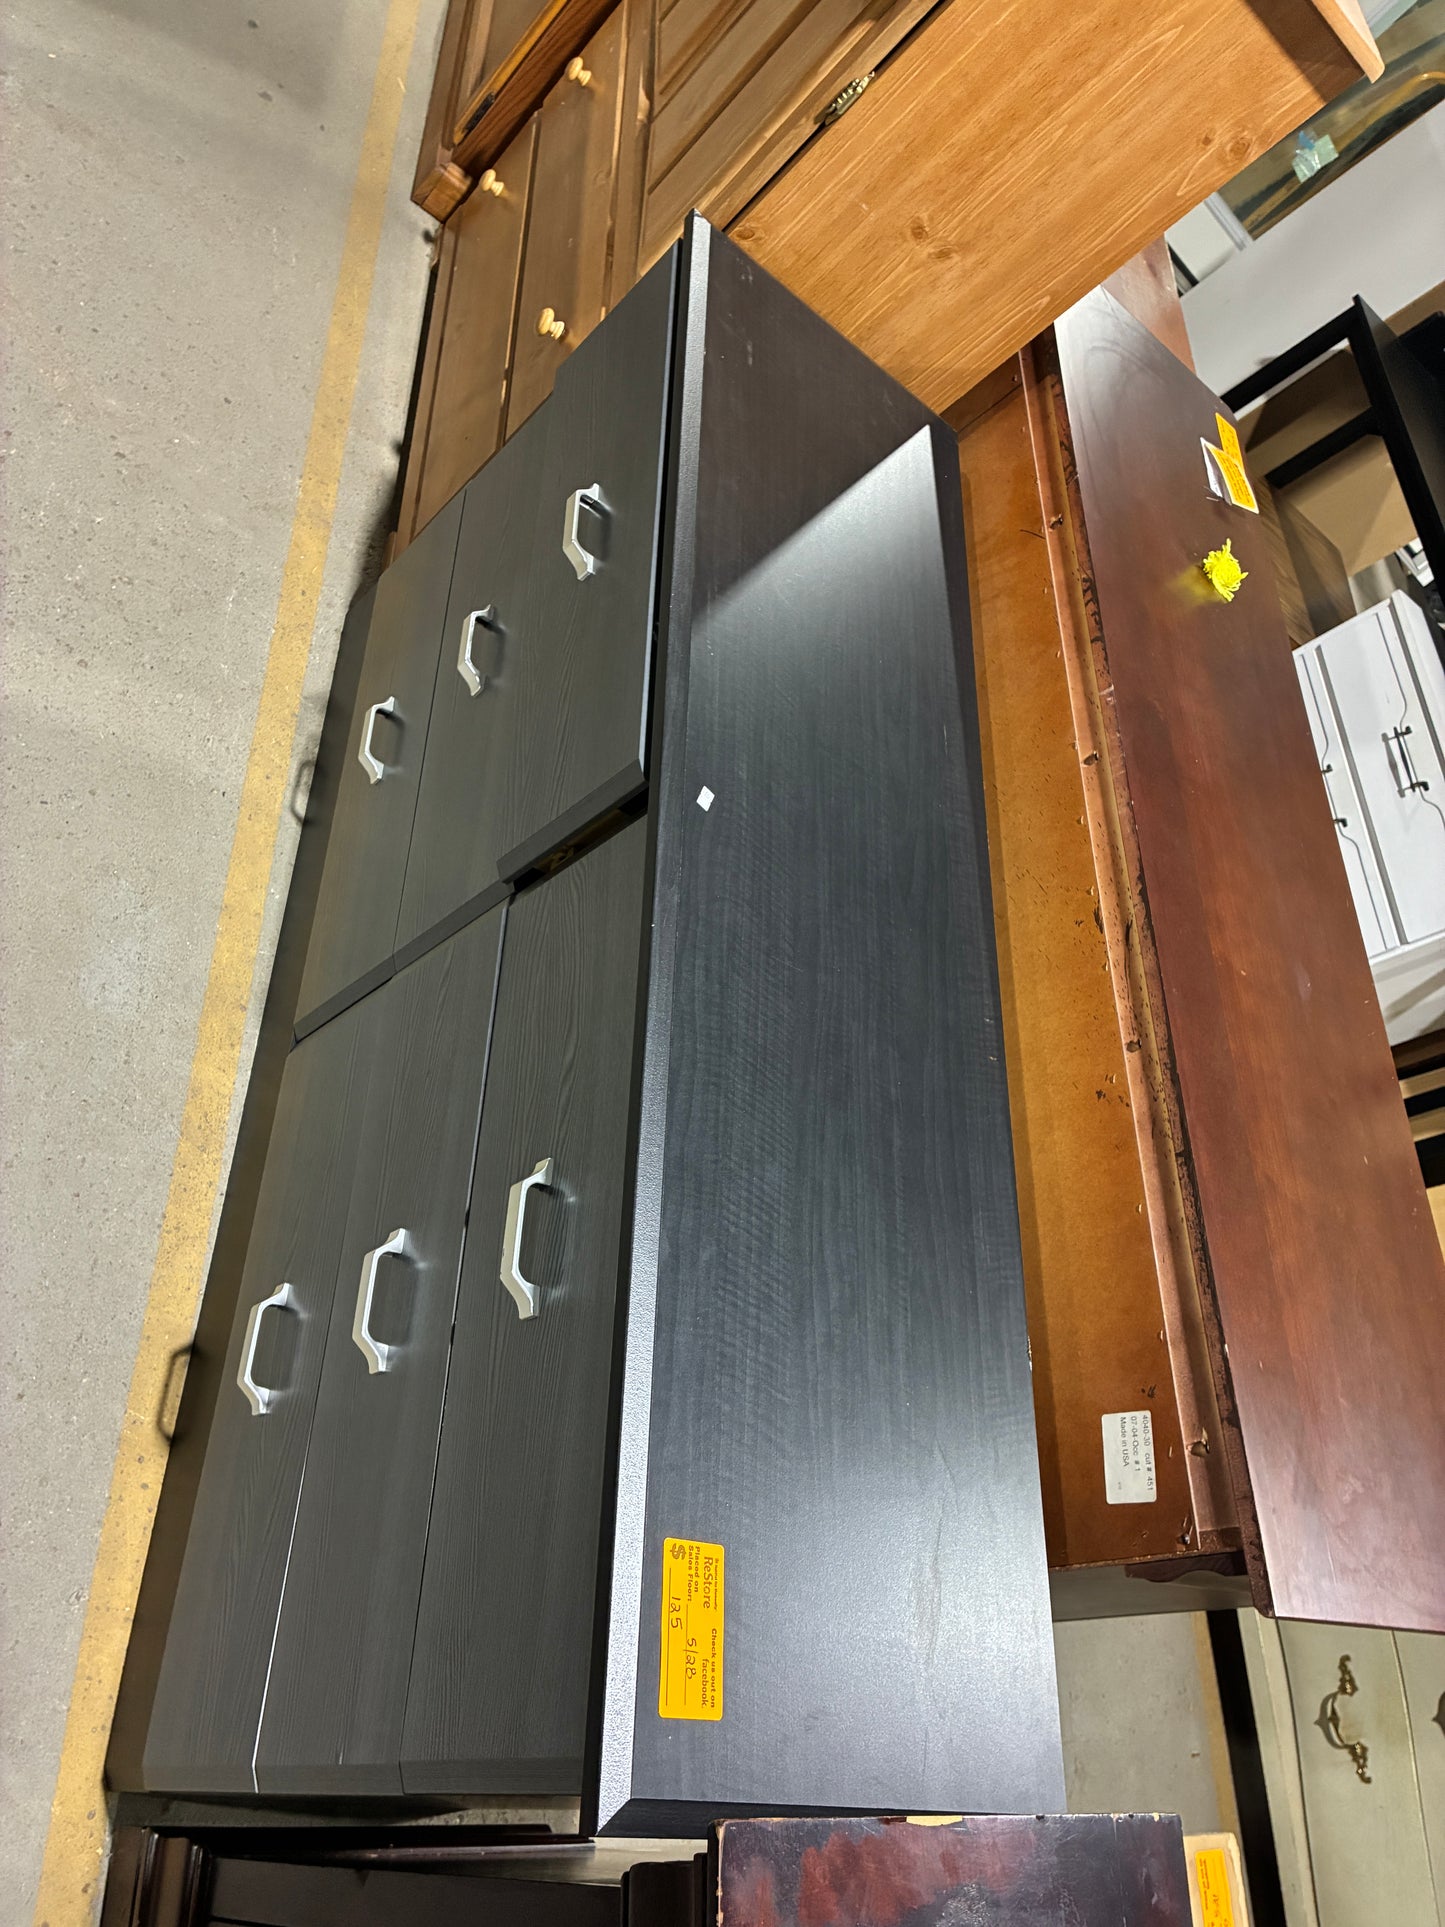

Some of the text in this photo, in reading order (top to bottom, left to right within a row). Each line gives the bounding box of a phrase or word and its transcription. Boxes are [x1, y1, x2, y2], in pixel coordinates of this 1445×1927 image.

[1143, 1414, 1151, 1447] 4040-30
[1122, 1439, 1127, 1447] in
[669, 1543, 686, 1560] $
[693, 1580, 699, 1592] on
[703, 1556, 714, 1609] ReStore
[670, 1596, 683, 1630] 125
[683, 1637, 699, 1680] 5/28
[711, 1662, 716, 1672] us
[710, 1695, 715, 1708] on
